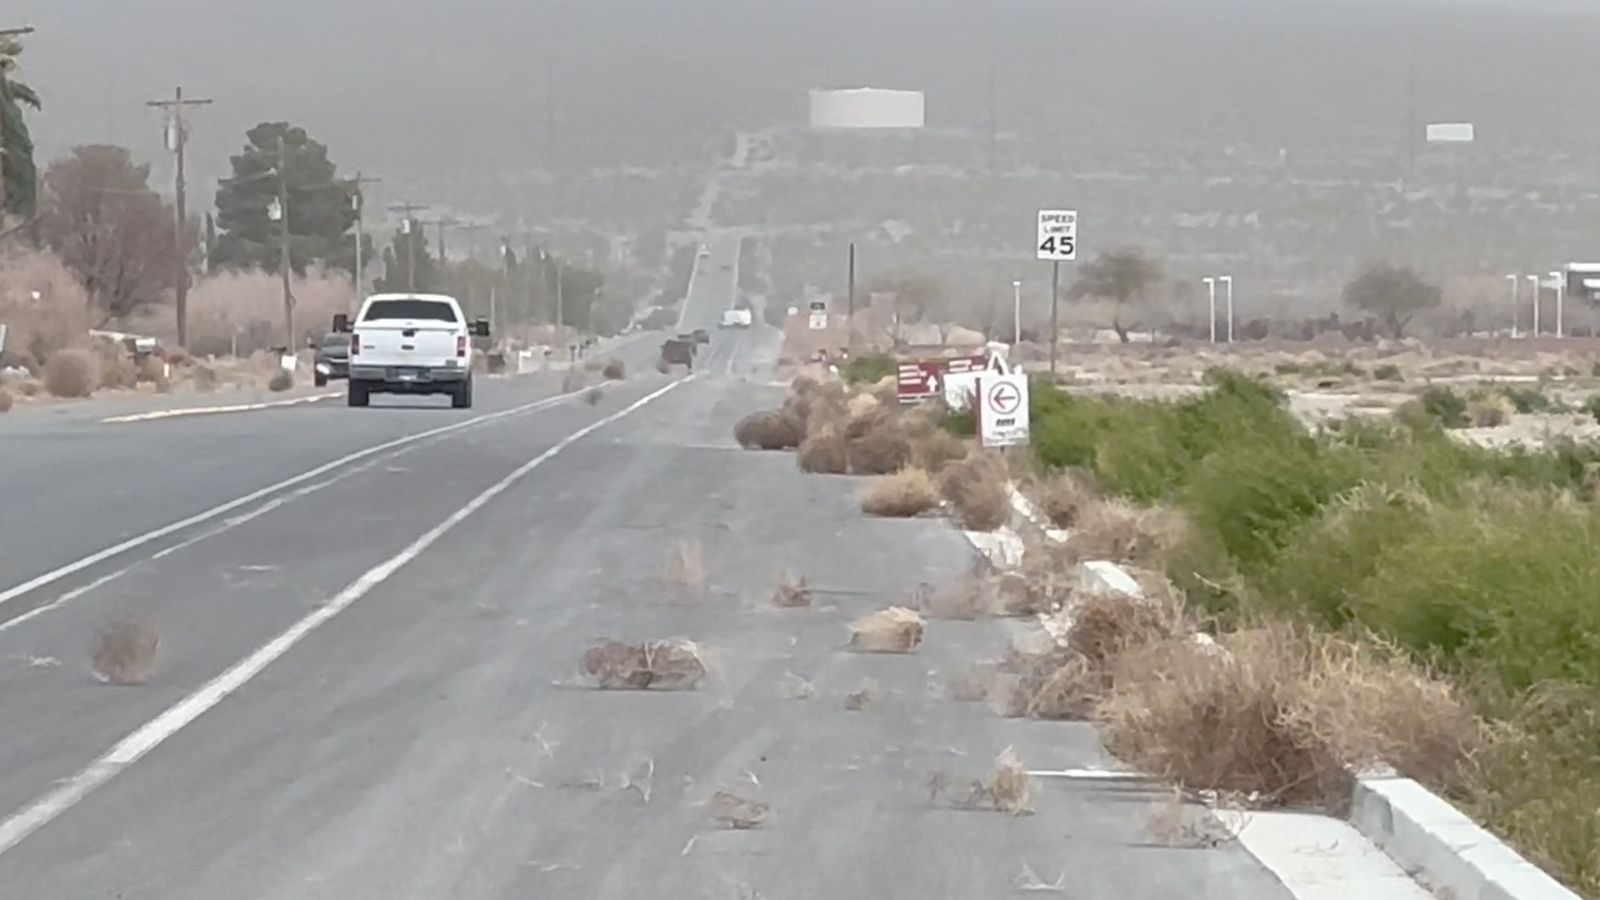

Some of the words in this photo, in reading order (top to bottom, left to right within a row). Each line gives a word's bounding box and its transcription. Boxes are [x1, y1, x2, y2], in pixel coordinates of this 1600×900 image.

[1041, 214, 1074, 223] SPEED
[1044, 225, 1070, 233] LIMIT
[1040, 236, 1074, 255] 45
